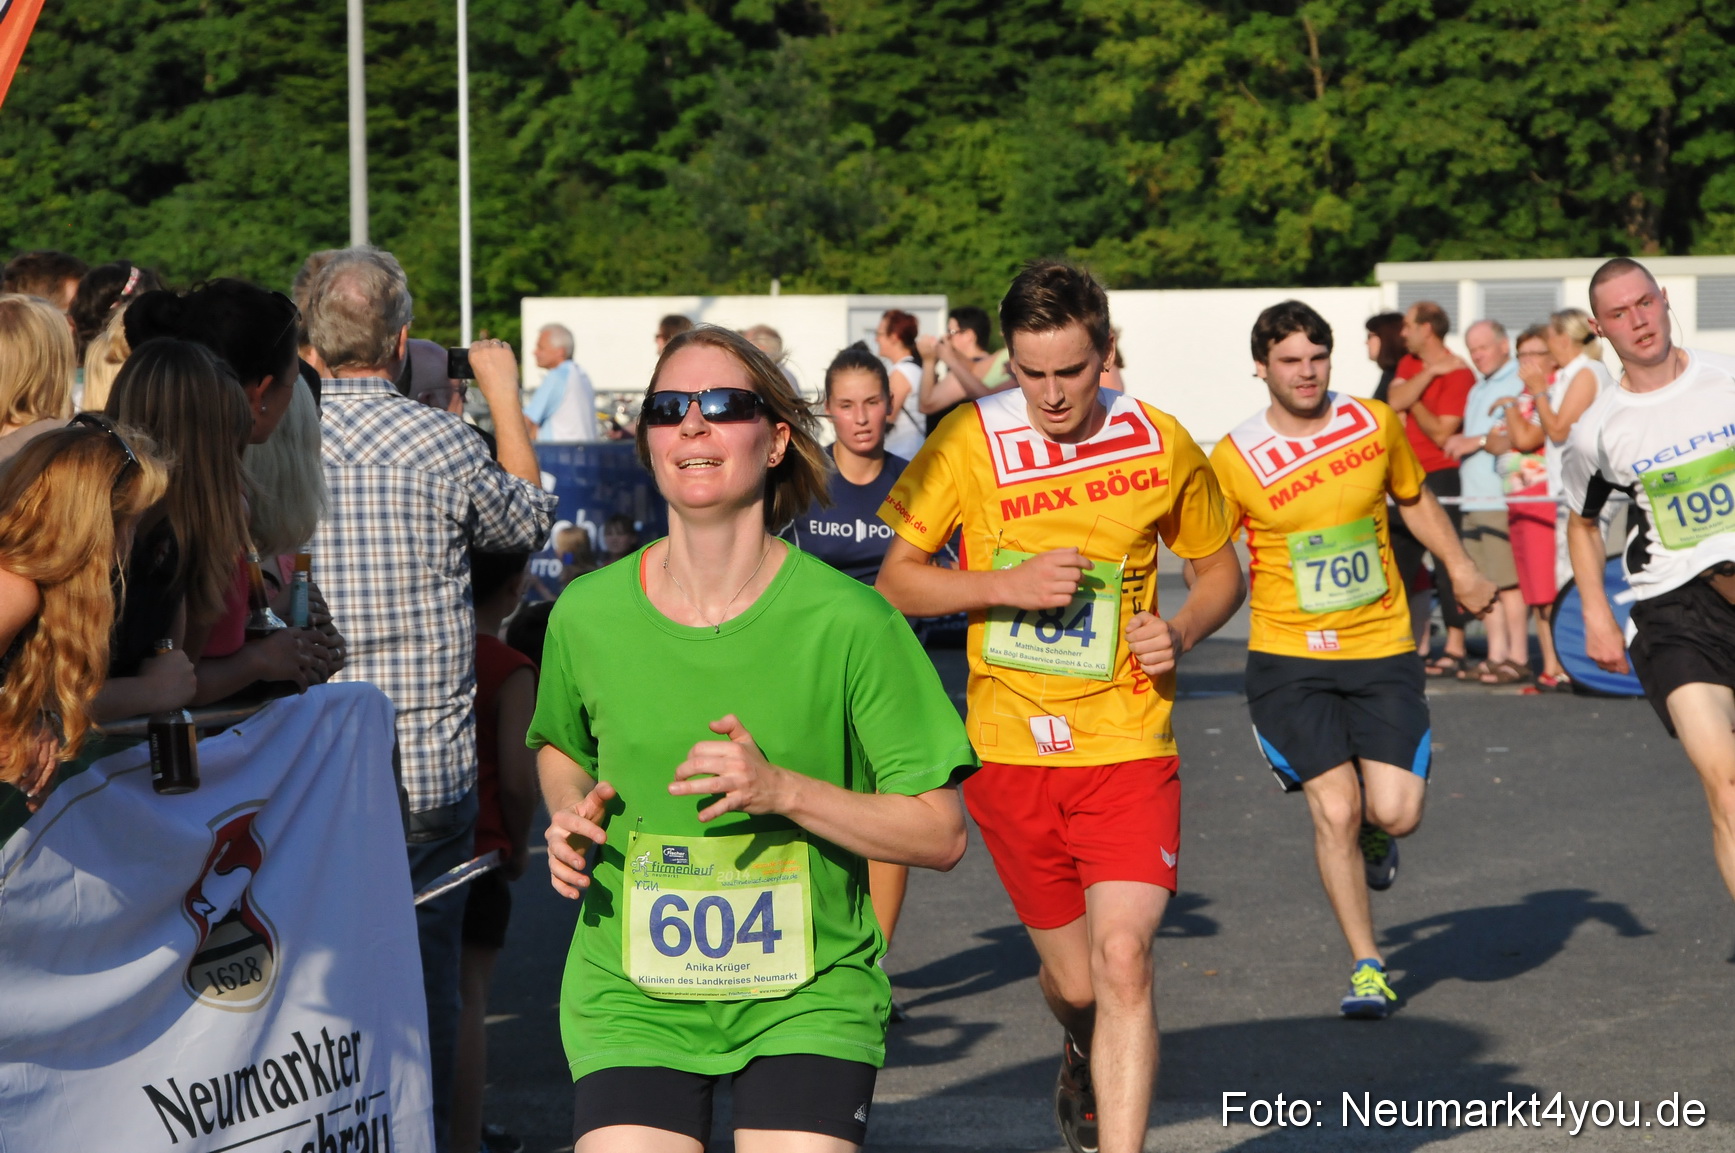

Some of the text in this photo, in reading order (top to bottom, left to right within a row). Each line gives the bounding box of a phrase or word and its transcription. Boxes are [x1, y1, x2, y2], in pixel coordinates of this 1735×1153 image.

[1000, 467, 1169, 521] MAX BÖGL
[1268, 441, 1386, 511] MAX BÖGL
[1667, 483, 1735, 528] 199
[809, 520, 853, 537] EURO
[1306, 551, 1370, 592] 760
[989, 647, 1002, 655] Max
[1003, 649, 1018, 659] Bögl
[1020, 653, 1054, 664] Bauservice
[1055, 658, 1076, 667] GmbH
[1083, 661, 1094, 669] Co.
[1014, 642, 1082, 657] Matthias Schönherr
[652, 861, 751, 882] firmenlauf 2014
[649, 891, 782, 959] 604
[204, 956, 263, 996] 1628
[638, 972, 798, 986] Kliniken des Landkreises Neumarkt
[685, 962, 751, 973] Anika Krüger
[142, 1026, 361, 1145] Neumarkter
